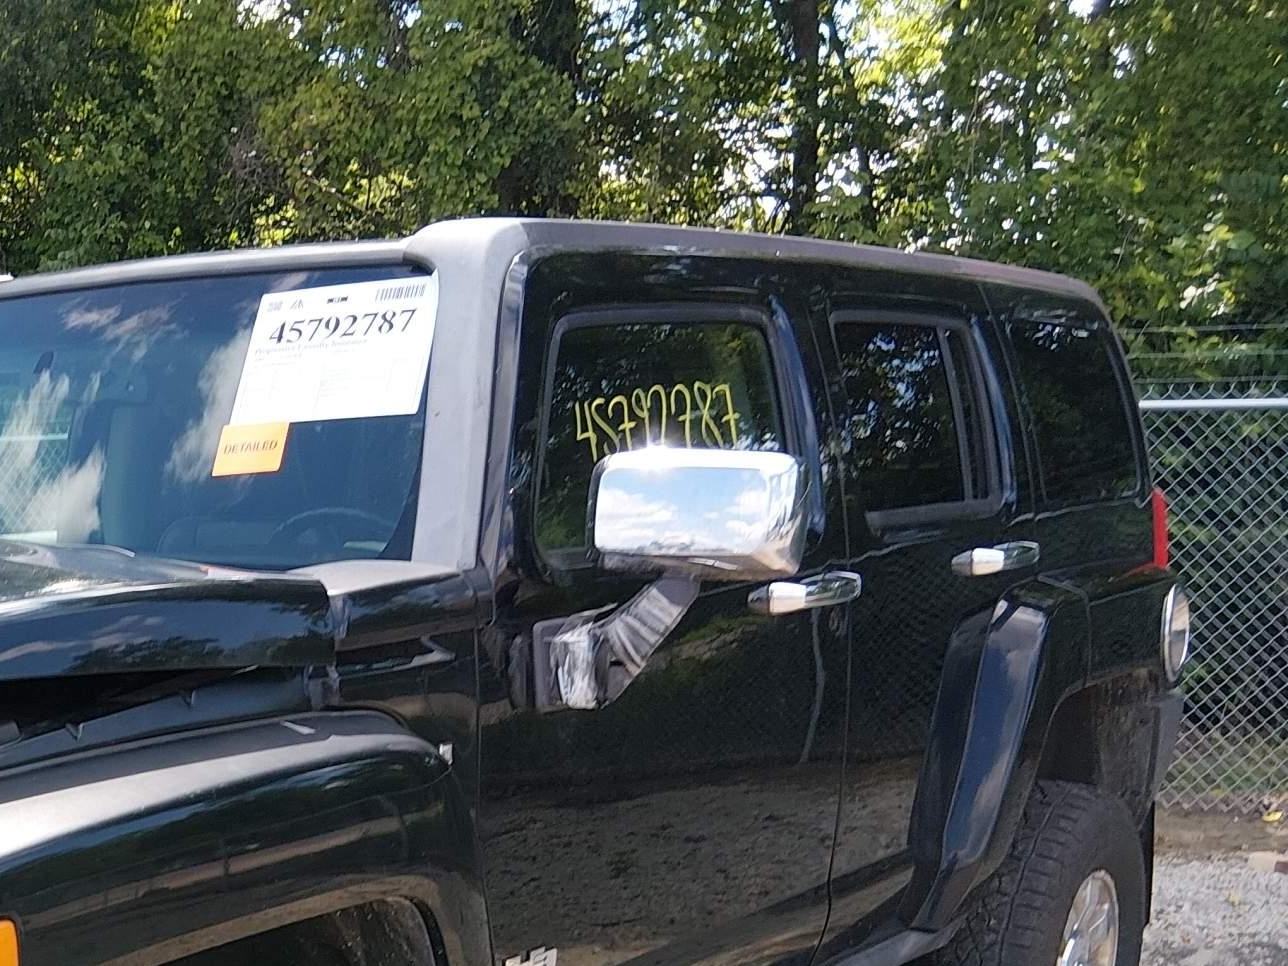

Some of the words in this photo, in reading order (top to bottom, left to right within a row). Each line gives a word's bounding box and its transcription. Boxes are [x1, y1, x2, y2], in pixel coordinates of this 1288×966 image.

[269, 308, 418, 344] 45792787
[574, 380, 741, 462] 45792787
[223, 438, 278, 455] DETAILED
